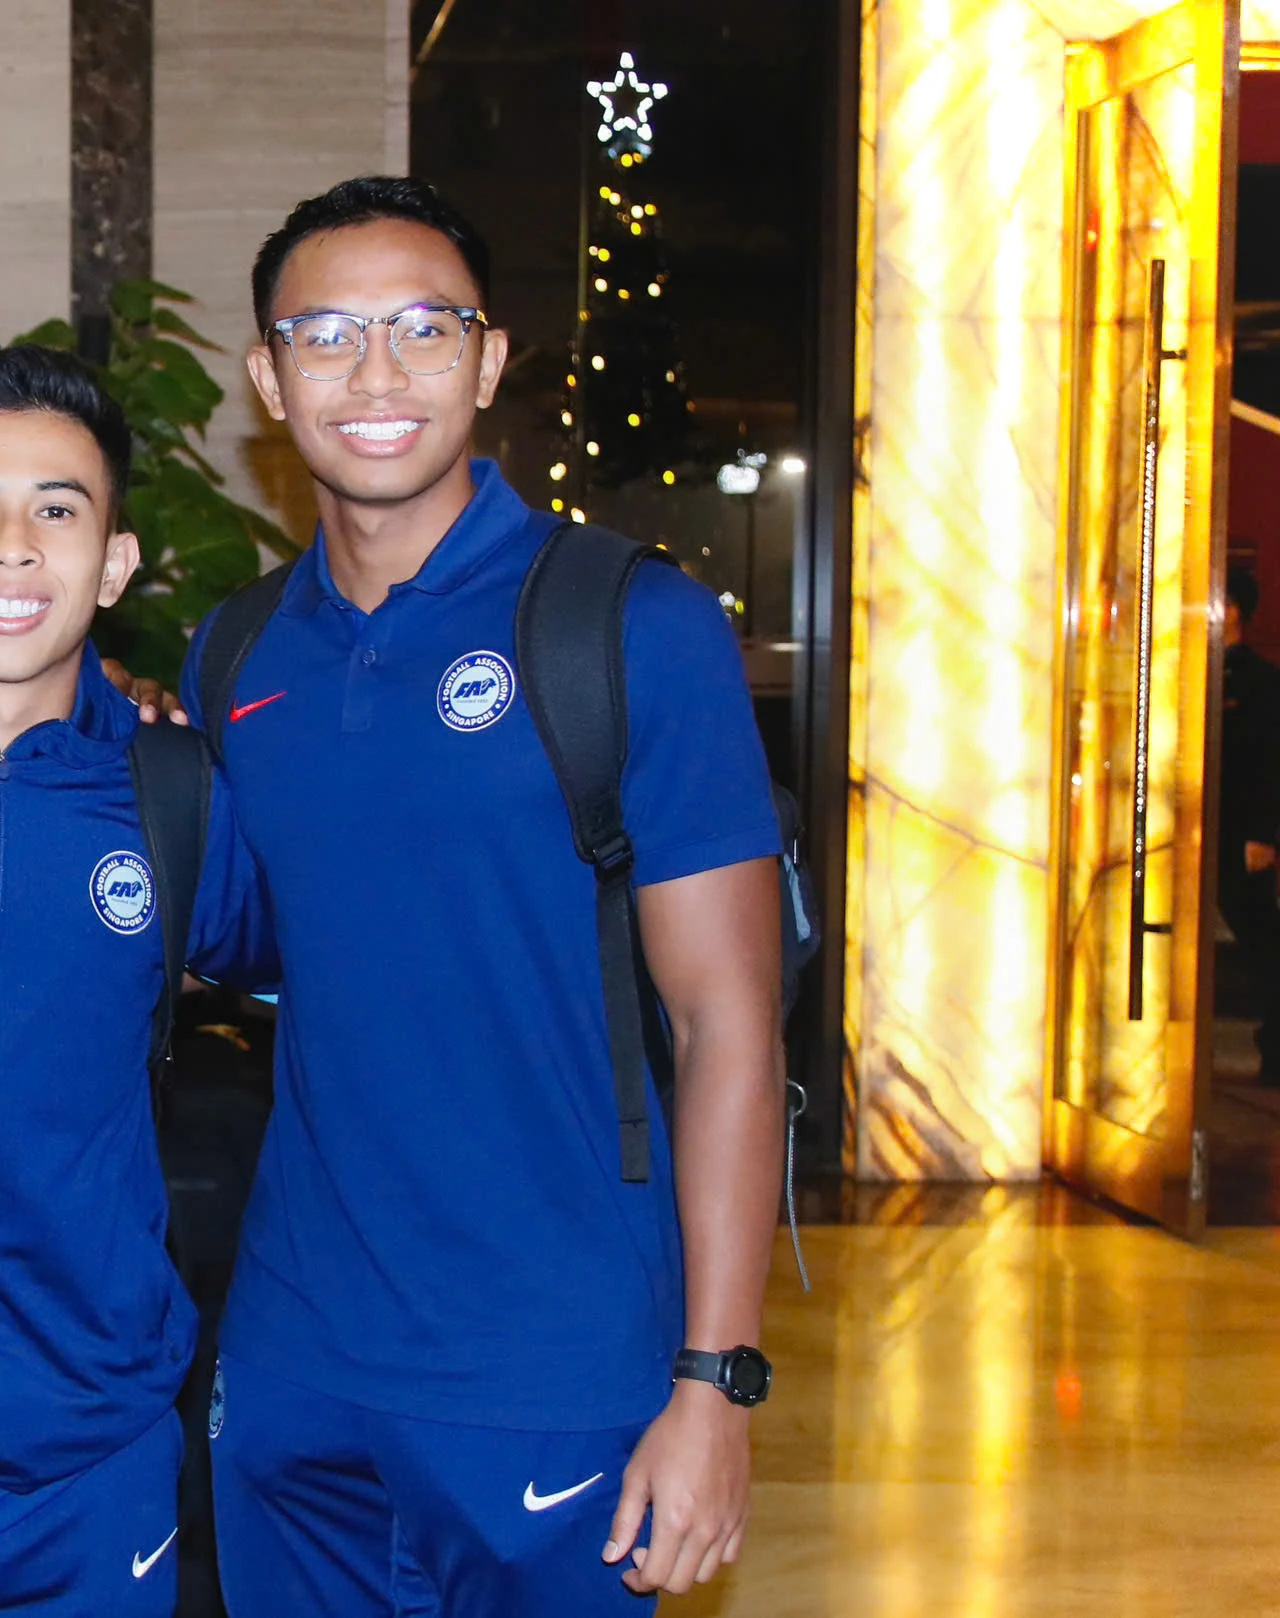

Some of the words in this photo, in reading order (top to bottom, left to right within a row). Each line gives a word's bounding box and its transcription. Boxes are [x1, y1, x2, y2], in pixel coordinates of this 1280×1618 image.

[442, 661, 470, 701] FOOTBALL
[475, 657, 508, 701] ASSOCIATION
[446, 710, 495, 726] SINGAPORE
[96, 858, 120, 896] FOOTBALL
[123, 857, 152, 906] ASSOCIATION
[103, 907, 144, 927] SINGAPORE
